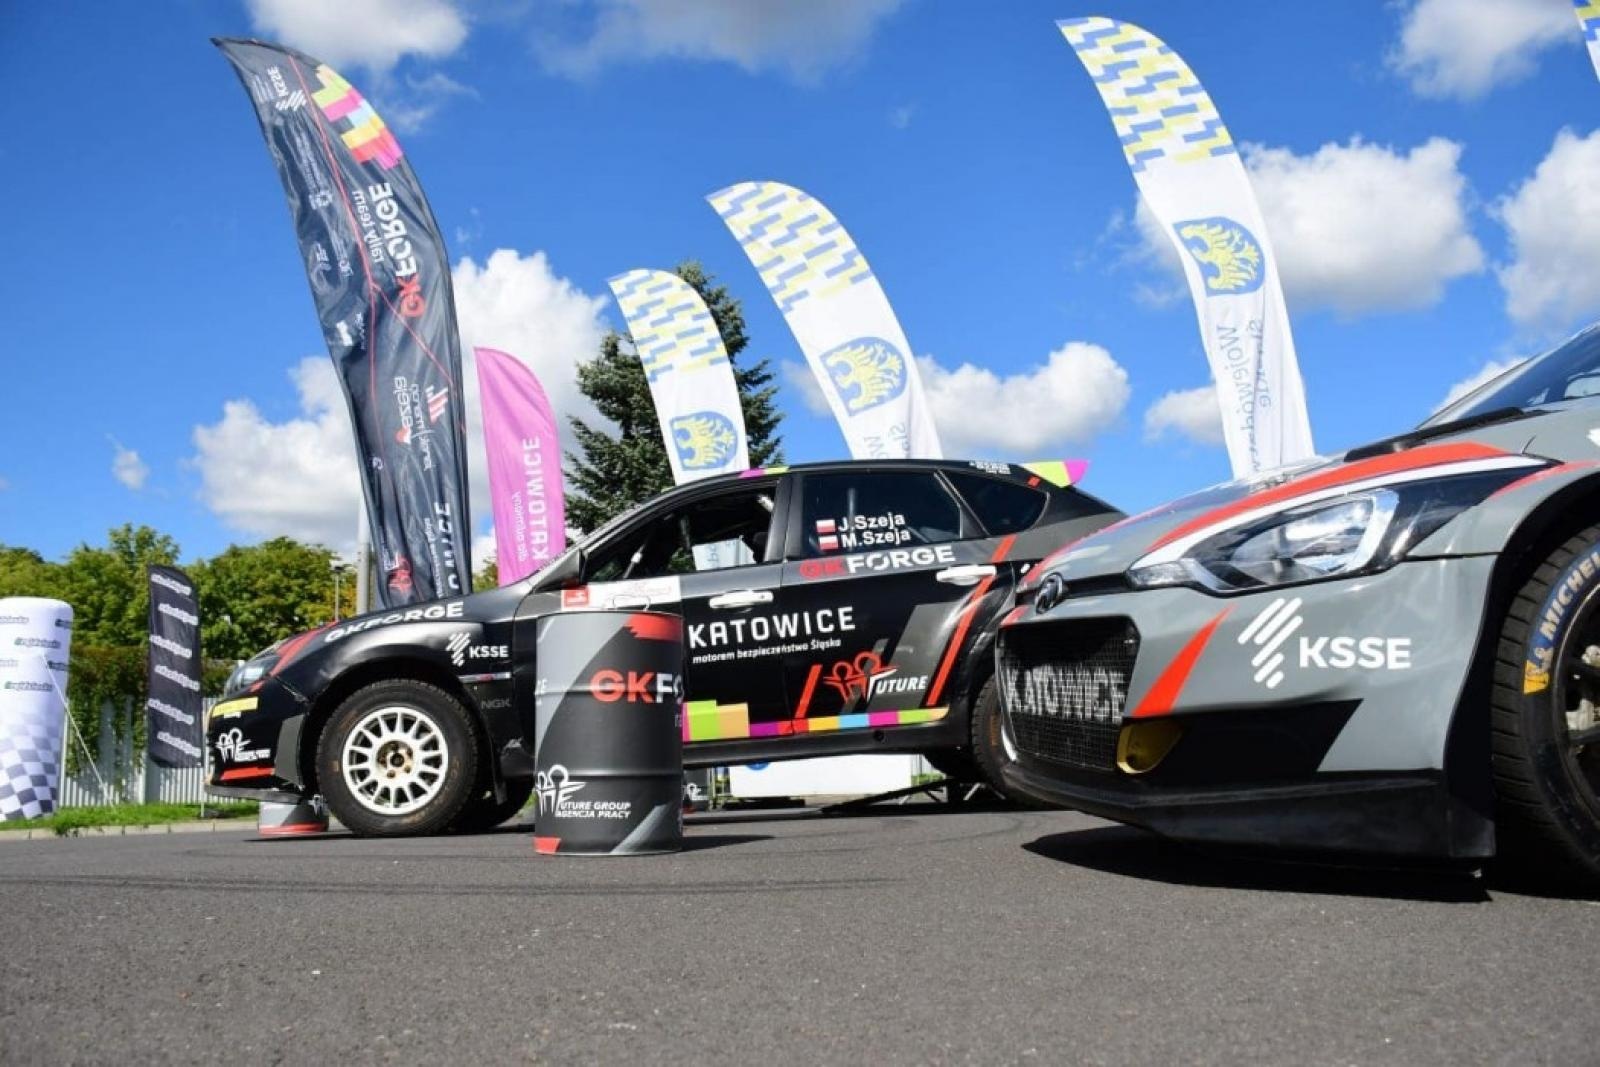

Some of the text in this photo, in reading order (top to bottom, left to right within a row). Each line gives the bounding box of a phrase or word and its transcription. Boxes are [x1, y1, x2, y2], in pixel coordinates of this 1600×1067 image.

[838, 512, 906, 532] J.Szeja
[840, 528, 911, 549] M.Szeja
[799, 545, 956, 579] GKFORGE
[688, 606, 856, 649] KATOWICE
[469, 645, 509, 658] KSSE
[692, 651, 735, 664] motorem
[1300, 637, 1411, 669] KSSE
[1003, 664, 1125, 724] KATOWICE
[594, 801, 631, 811] GROUP
[598, 811, 631, 819] PRACY
